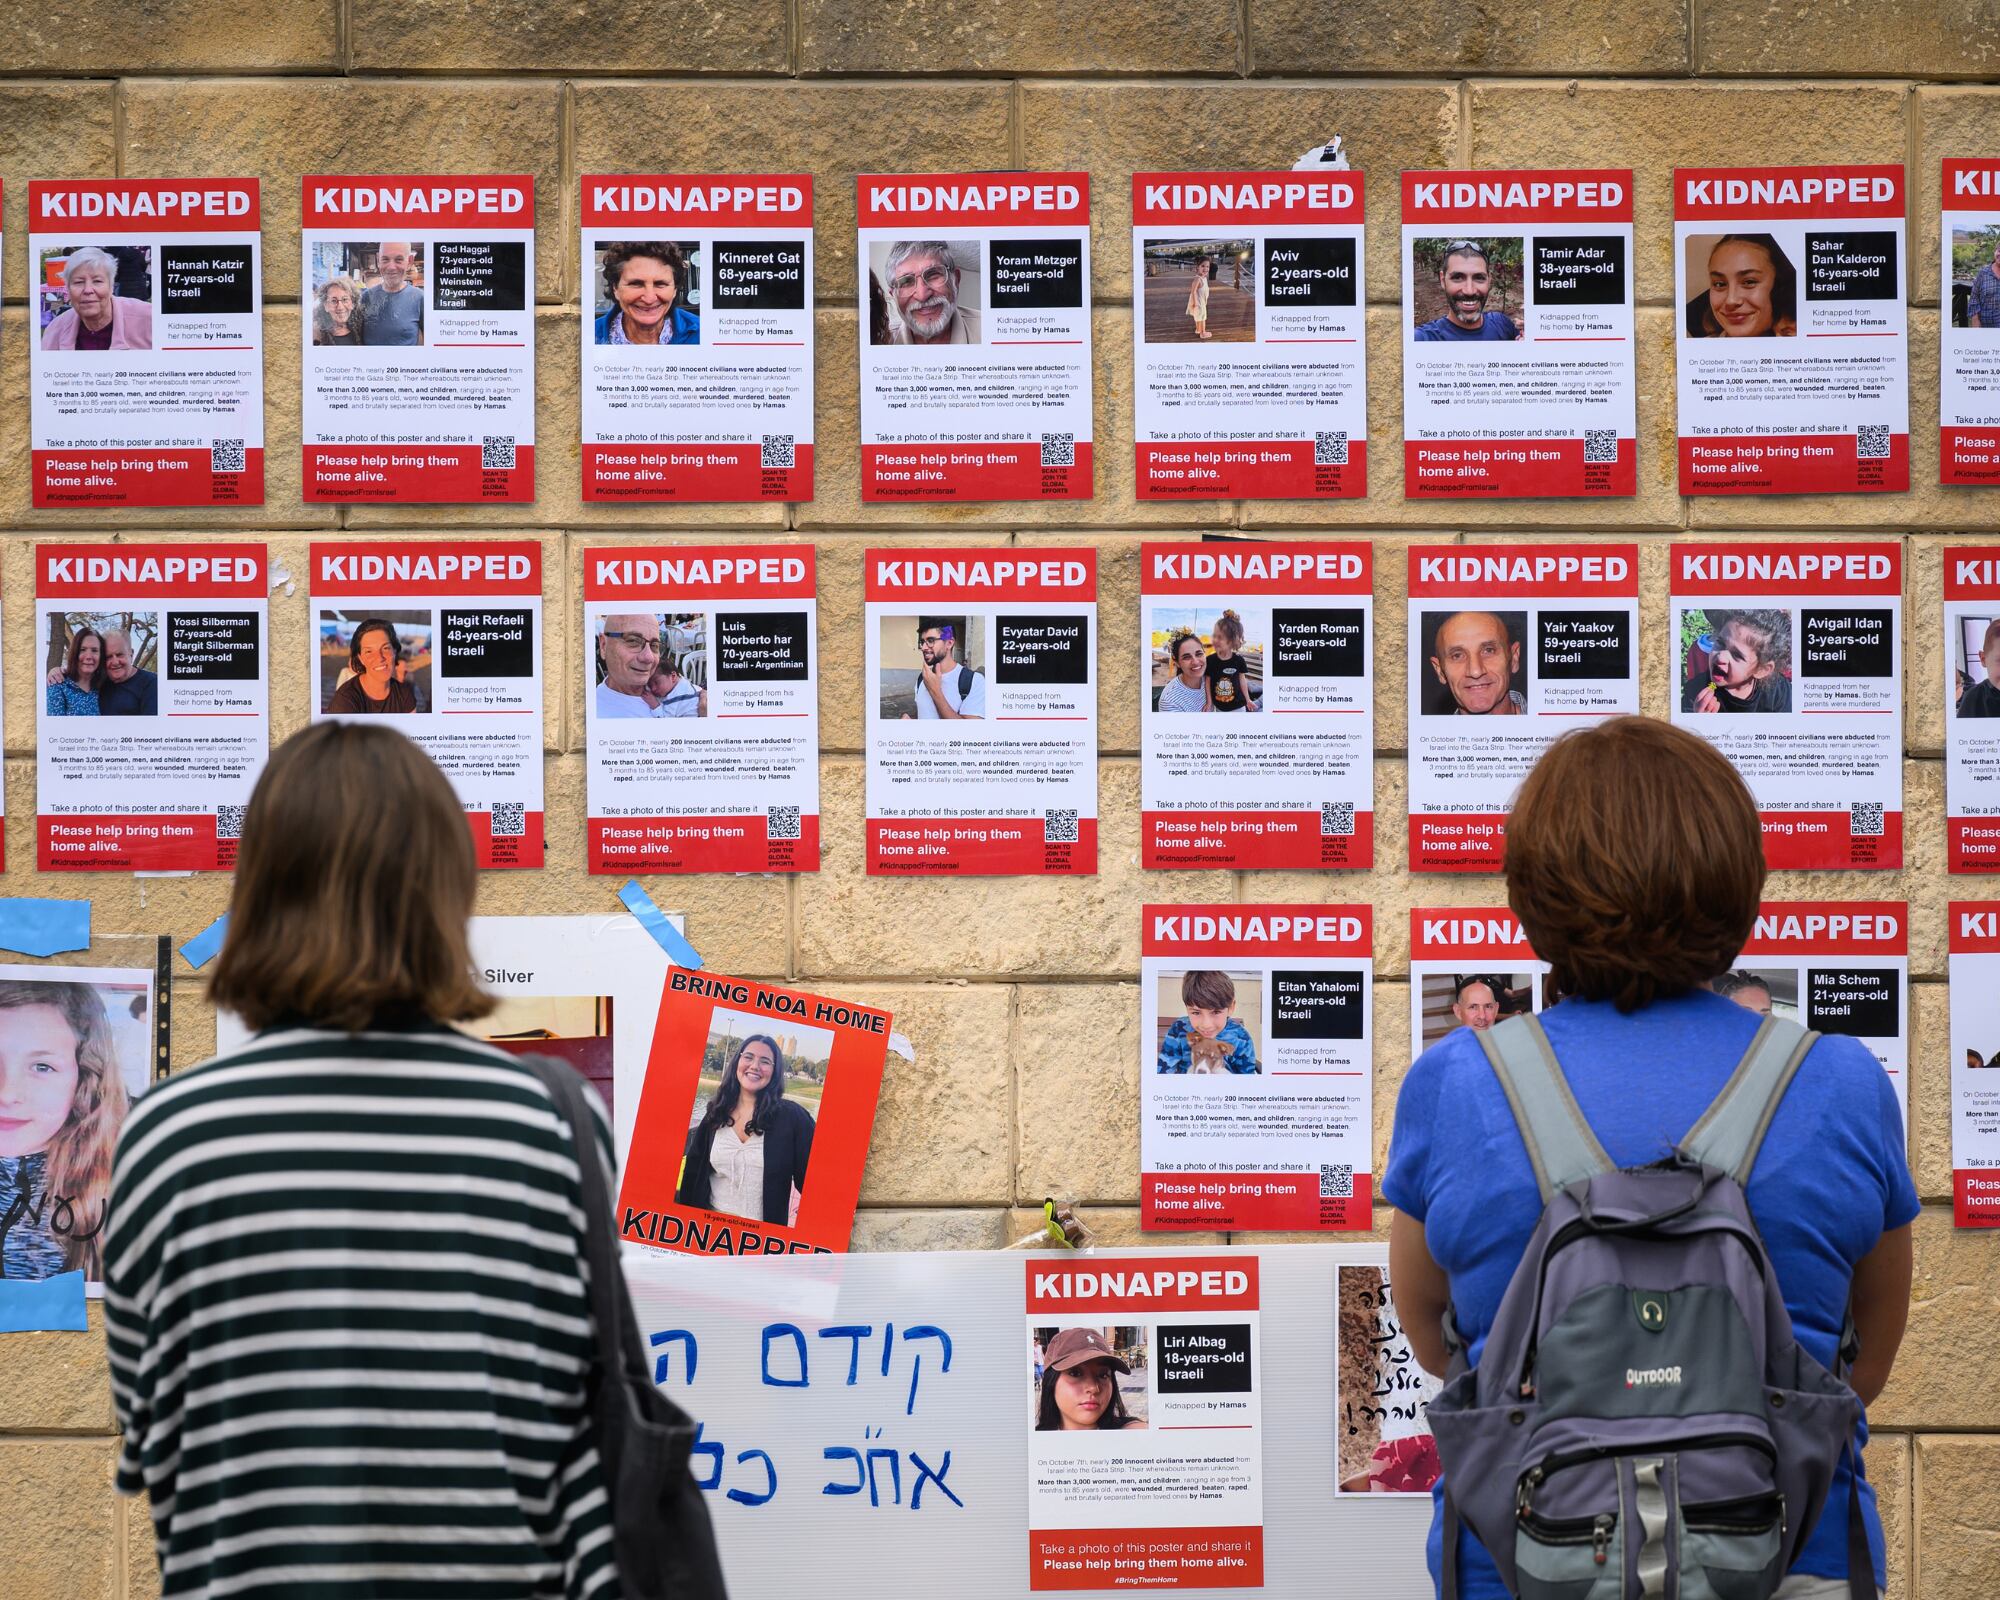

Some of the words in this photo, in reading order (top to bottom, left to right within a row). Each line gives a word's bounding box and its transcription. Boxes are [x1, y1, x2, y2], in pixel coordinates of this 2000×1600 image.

[1146, 184, 1354, 210] KIDNAPPED
[1414, 182, 1623, 208] KIDNAPPED
[1687, 178, 1894, 205] KIDNAPPED
[42, 191, 250, 217] KIDNAPPED
[315, 188, 524, 213] KIDNAPPED
[594, 187, 803, 212] KIDNAPPED
[871, 185, 1080, 212] KIDNAPPED
[440, 245, 458, 253] Gad
[460, 245, 490, 255] Haggai
[1812, 241, 1844, 251] Sahar
[720, 252, 774, 264] Kinneret
[777, 252, 800, 264] Gat
[1271, 250, 1300, 261] Aviv
[1539, 248, 1574, 258] Tamir
[1576, 248, 1605, 258] Adar
[1812, 254, 1834, 264] Dan
[1837, 254, 1886, 264] Kalderon
[168, 260, 209, 270] Hannah
[212, 260, 244, 269] Katzir
[440, 256, 493, 266] 73-years-old
[996, 256, 1031, 265] Yoram
[1034, 255, 1078, 267] Metzger
[440, 267, 464, 275] Judih
[466, 267, 493, 277] Lynne
[719, 268, 798, 282] 68-years-old
[996, 269, 1064, 281] 80-years-old
[1271, 266, 1348, 282] 2-years-old
[1540, 262, 1614, 276] 38-years-old
[1812, 267, 1879, 280] 16-years-old
[168, 273, 234, 286] 77-years-old
[440, 278, 482, 286] Weinstein
[1540, 278, 1576, 289] Israeli
[168, 287, 200, 297] Israeli
[440, 288, 493, 298] 70-years-old
[719, 284, 758, 296] Israeli
[997, 283, 1030, 293] Israeli
[1271, 284, 1310, 295] Israeli
[1812, 282, 1845, 292] Israeli
[440, 299, 466, 307] Israeli
[167, 322, 209, 331] Kidnapped
[168, 332, 180, 340] her
[182, 332, 202, 340] home
[204, 332, 214, 341] by
[1150, 452, 1190, 463] Please
[1194, 452, 1221, 465] help
[1224, 452, 1257, 464] bring
[1260, 451, 1291, 462] them
[48, 558, 257, 582] KIDNAPPED
[322, 555, 531, 581] KIDNAPPED
[596, 558, 805, 585] KIDNAPPED
[1154, 554, 1363, 579] KIDNAPPED
[1420, 557, 1628, 582] KIDNAPPED
[1683, 555, 1891, 580] KIDNAPPED
[878, 561, 1086, 586] KIDNAPPED
[174, 618, 199, 626] Yossi
[202, 617, 250, 626] Silberman
[448, 615, 480, 628] Hagit
[483, 614, 524, 625] Refaeli
[722, 621, 746, 631] Luis
[1808, 617, 1851, 631] Avigail
[1855, 618, 1882, 628] Idan
[1003, 626, 1045, 639] Evyatar
[1047, 626, 1078, 636] David
[1279, 624, 1317, 633] Yarden
[1320, 624, 1359, 633] Roman
[1544, 622, 1568, 633] Yair
[1571, 622, 1614, 632] Yaakov
[173, 629, 232, 640] 67-years-old
[447, 630, 522, 644] 48-years-old
[722, 635, 771, 645] Norberto
[774, 634, 792, 644] har
[1808, 634, 1879, 647] 3-years-old
[174, 641, 204, 652] Margit
[206, 641, 254, 650] Silberman
[1002, 640, 1070, 652] 22-years-old
[1279, 637, 1346, 649] 36-years-old
[1544, 637, 1618, 650] 59-years-old
[448, 645, 484, 656] Israeli
[722, 648, 790, 660] 70-years-old
[1279, 651, 1312, 661] Israeli
[1808, 650, 1846, 661] Israeli
[173, 653, 232, 664] 63-years-old
[1002, 654, 1036, 664] Israeli
[1544, 652, 1581, 663] Israeli
[174, 665, 202, 674] Israeli
[723, 661, 748, 669] Israeli
[755, 660, 804, 670] Argentinian
[879, 828, 920, 839] Please
[924, 828, 951, 842] help
[954, 828, 987, 842] bring
[990, 828, 1021, 839] them
[879, 844, 914, 855] home
[917, 844, 950, 855] alive.
[1154, 916, 1362, 942] KIDNAPPED
[1754, 915, 1898, 940] NAPPED
[484, 969, 534, 983] Silver
[1814, 974, 1835, 985] Mia
[1839, 974, 1880, 985] Schem
[1278, 982, 1306, 992] Eitan
[1309, 982, 1359, 992] Yahalomi
[1278, 996, 1346, 1008] 12-years-old
[1814, 990, 1888, 1002] 21-years-old
[671, 973, 748, 1004] BRING
[756, 990, 807, 1017] NOA
[815, 1003, 886, 1034] HOME
[1278, 1009, 1311, 1019] Israeli
[1814, 1005, 1850, 1015] Israeli
[1035, 1271, 1248, 1298] KIDNAPPED
[1164, 1336, 1185, 1348] Liri
[1188, 1336, 1226, 1350] Albag
[1164, 1352, 1244, 1366] 18-years-old
[762, 1322, 953, 1415] קודם
[1164, 1368, 1204, 1380] Israeli
[1626, 1366, 1682, 1385] OUTDOOR
[1165, 1402, 1206, 1410] Kidnapped
[1207, 1402, 1218, 1410] by
[1040, 1544, 1065, 1554] Take
[1068, 1546, 1075, 1554] a
[1078, 1544, 1110, 1555] photo
[1113, 1542, 1123, 1553] of
[1126, 1543, 1146, 1552] this
[1149, 1543, 1184, 1554] poster
[1187, 1541, 1208, 1552] and
[1211, 1541, 1242, 1552] share
[1245, 1542, 1251, 1551] it
[1044, 1560, 1082, 1570] Please
[1086, 1559, 1111, 1571] help
[1114, 1558, 1145, 1570] bring
[1148, 1558, 1178, 1568] them
[1181, 1557, 1214, 1567] home
[1217, 1556, 1247, 1567] alive.
[1115, 1576, 1178, 1585] #BringThemHome
